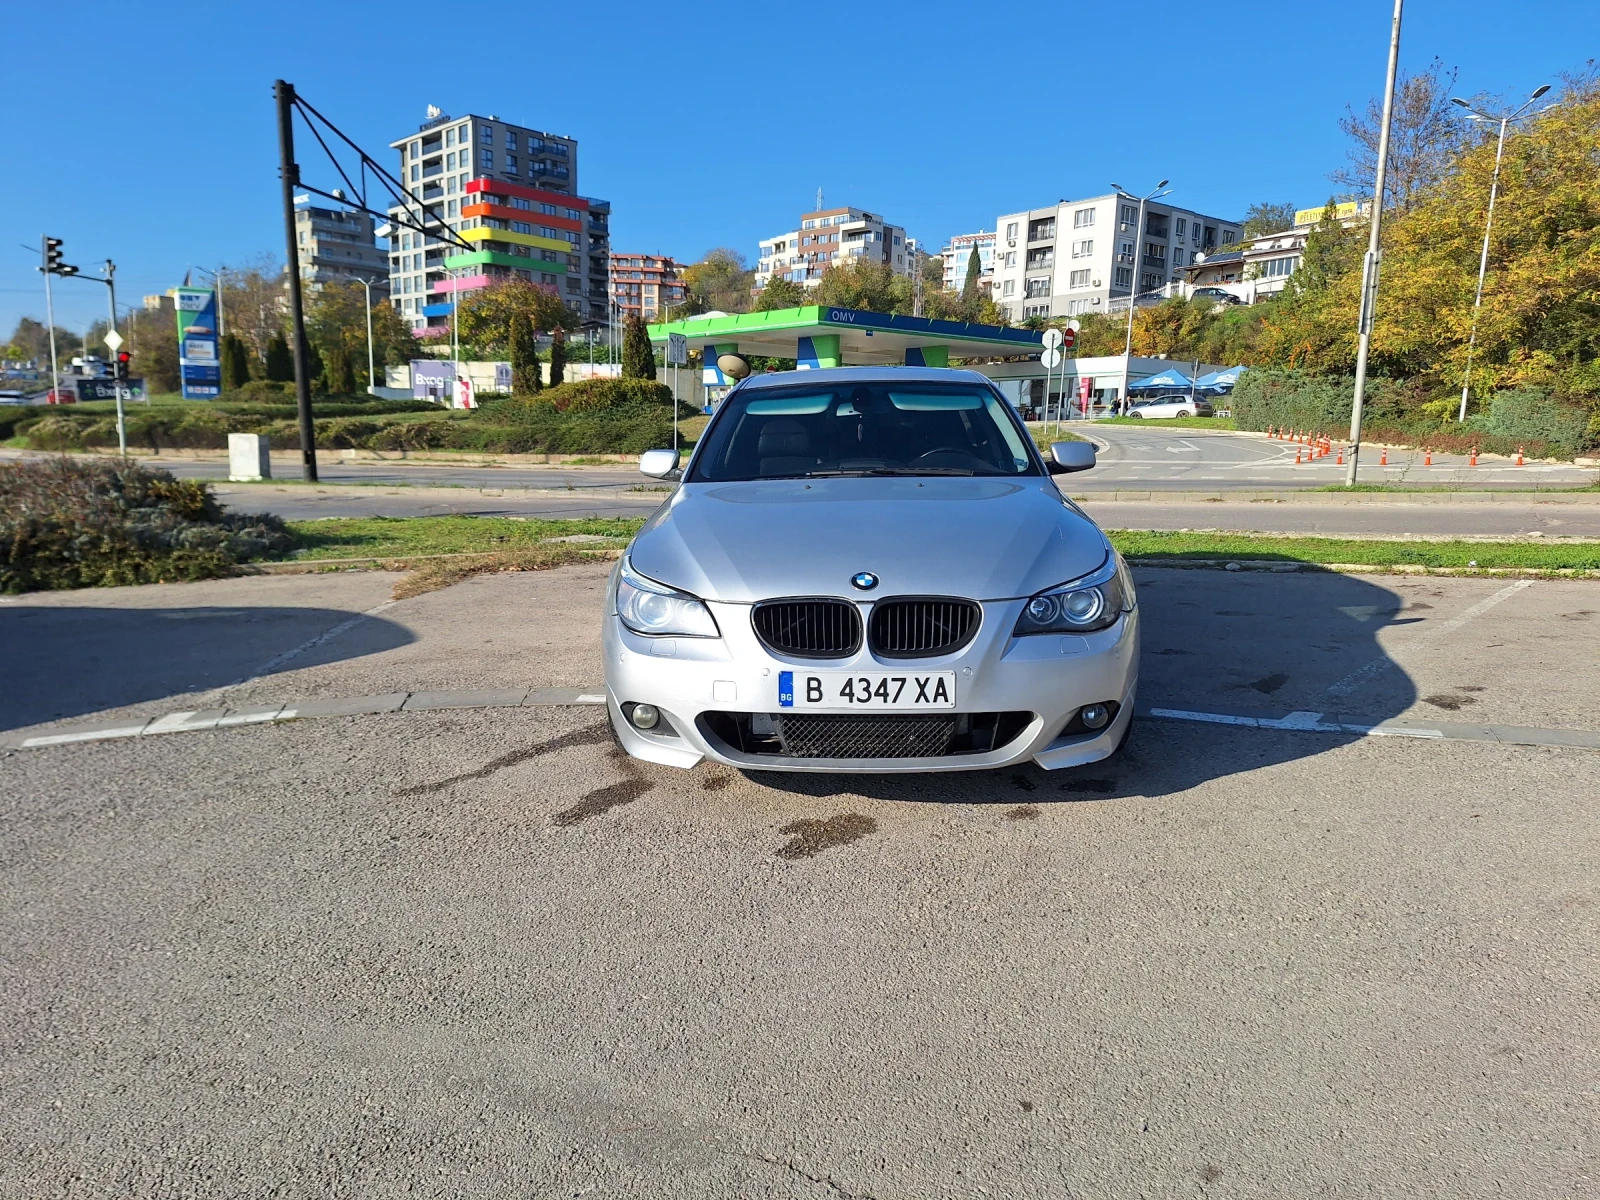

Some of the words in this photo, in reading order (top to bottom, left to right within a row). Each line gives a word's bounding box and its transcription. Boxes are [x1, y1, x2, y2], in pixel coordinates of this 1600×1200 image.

[832, 310, 856, 323] OMV
[839, 677, 907, 704] 4347
[914, 676, 949, 703] XA
[780, 693, 792, 701] BG
